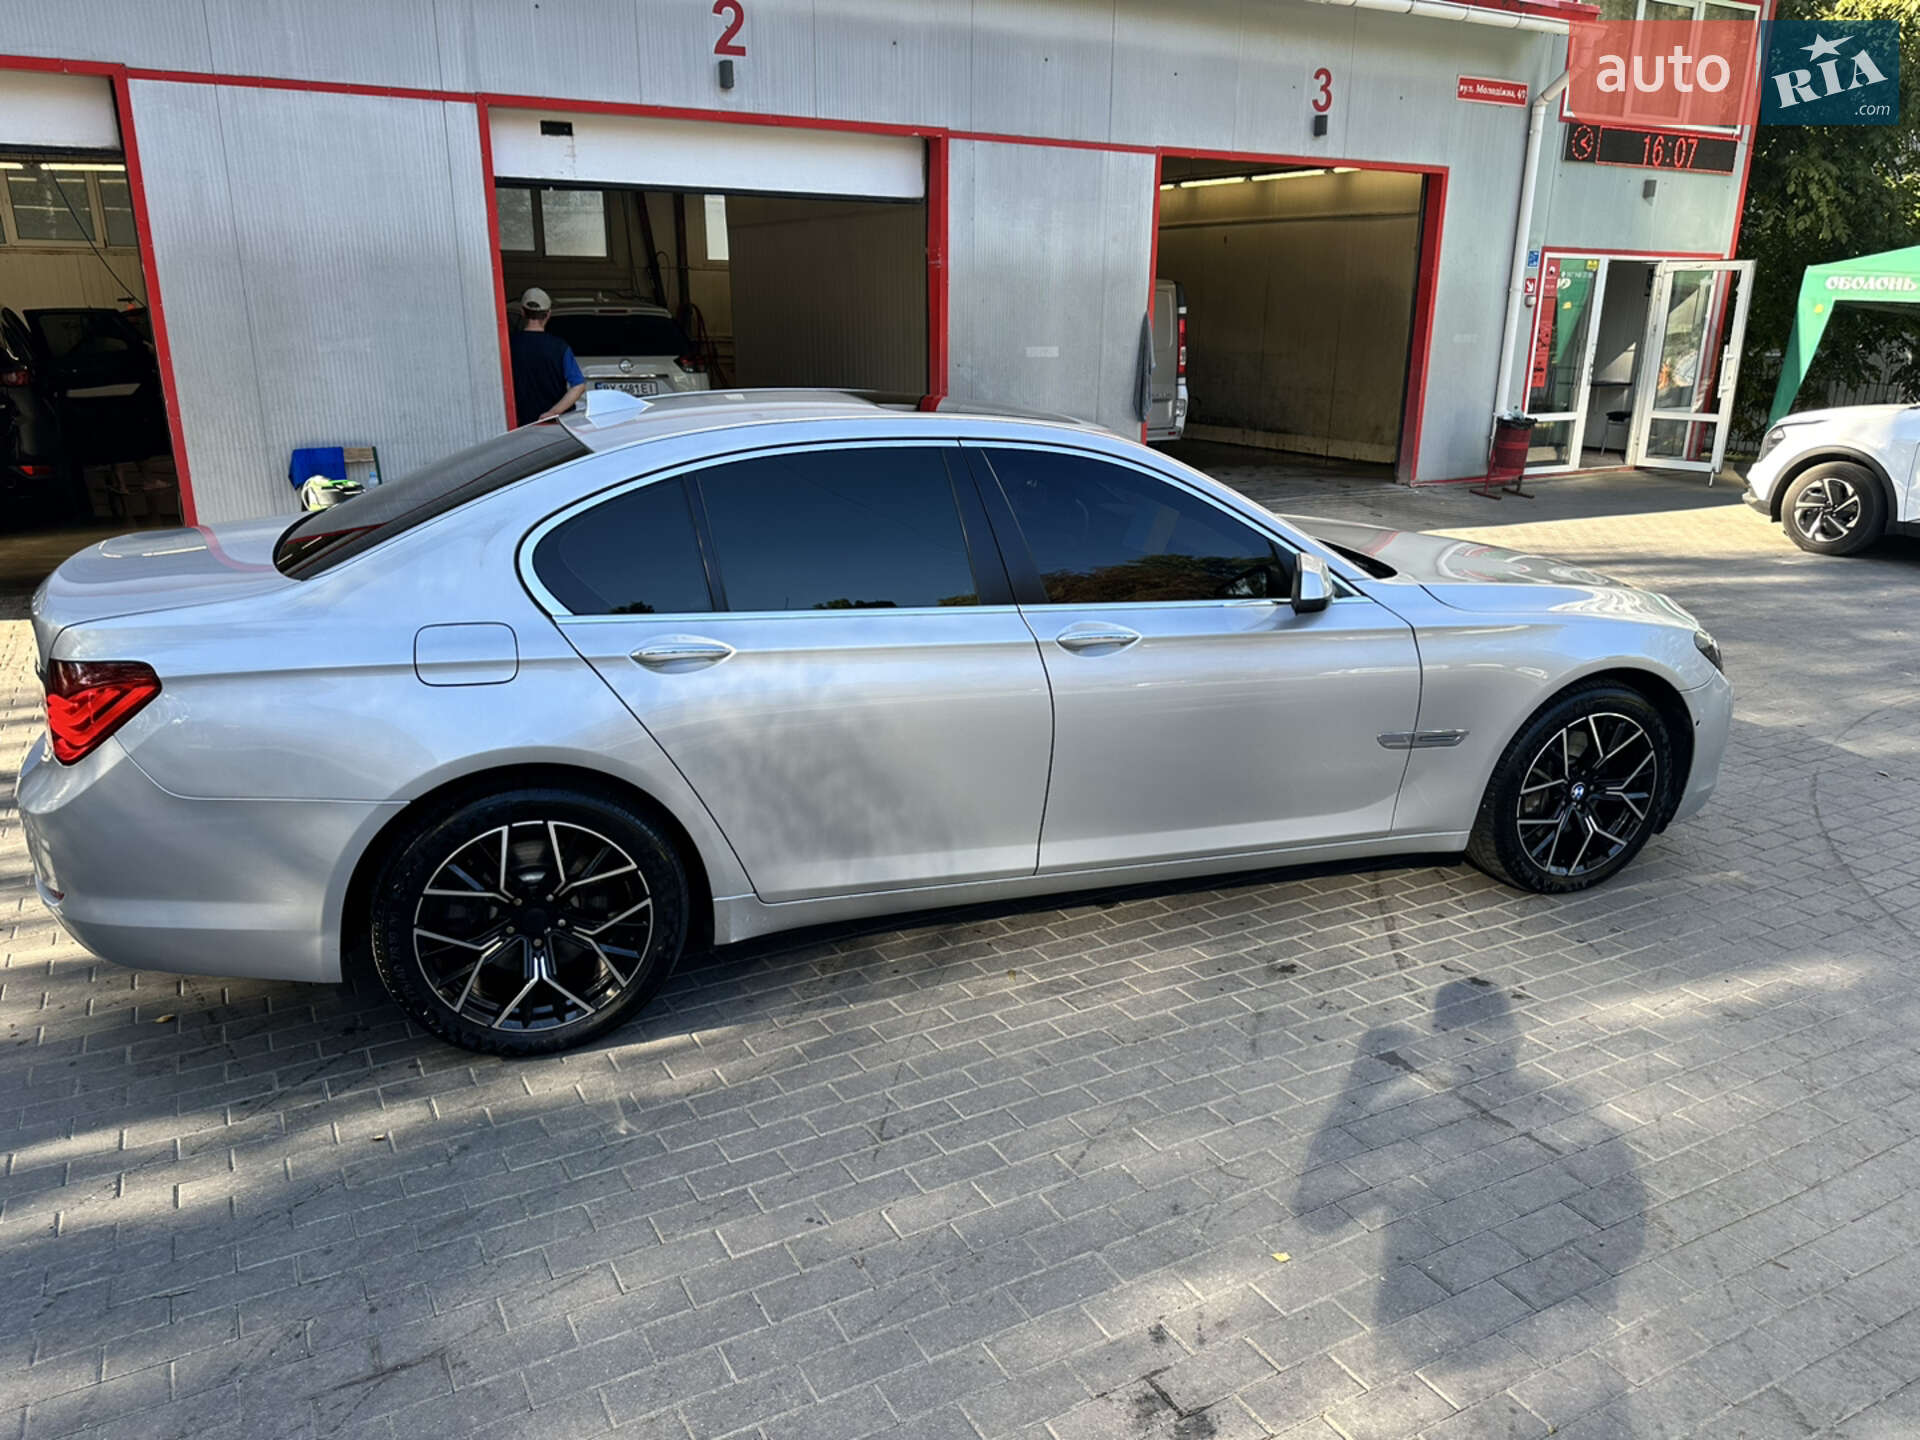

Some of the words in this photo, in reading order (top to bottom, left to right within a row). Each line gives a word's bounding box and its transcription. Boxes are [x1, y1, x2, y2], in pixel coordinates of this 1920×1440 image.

[713, 0, 746, 56] 2
[1312, 67, 1332, 113] 3
[1643, 135, 1698, 169] 16:07
[1825, 275, 1918, 292] ОБОЛОНЬ
